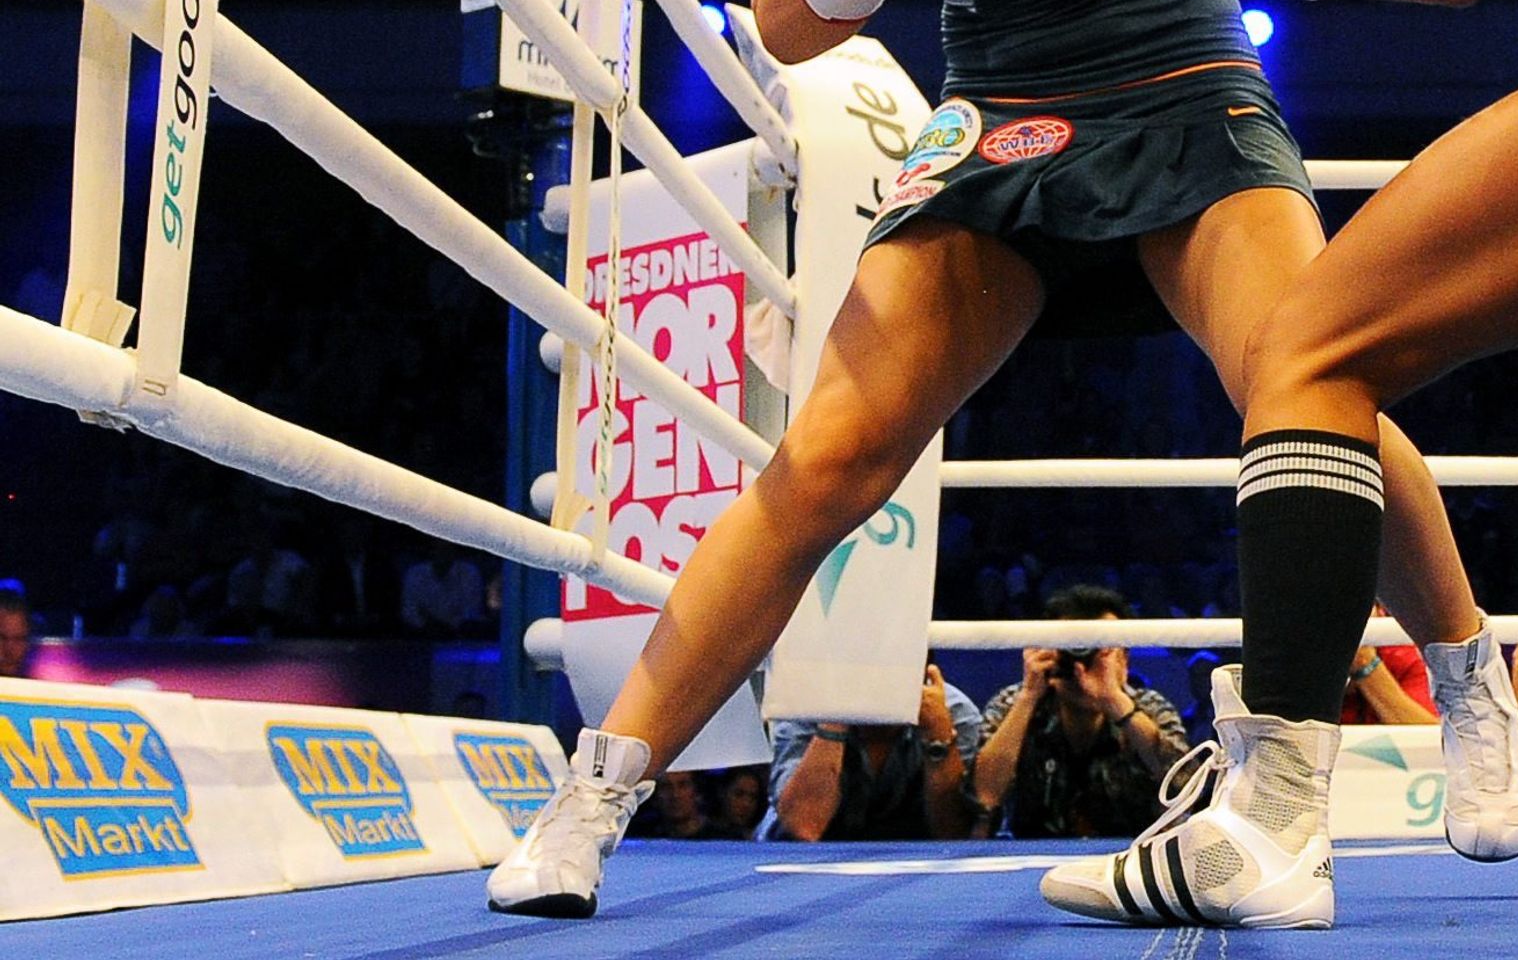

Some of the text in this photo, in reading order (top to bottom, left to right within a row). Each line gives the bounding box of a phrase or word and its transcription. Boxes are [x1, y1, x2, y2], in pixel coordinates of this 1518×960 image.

[0, 716, 173, 789] MIX
[274, 737, 402, 794] MIX
[459, 742, 550, 789] MIX
[44, 816, 191, 858] Markt
